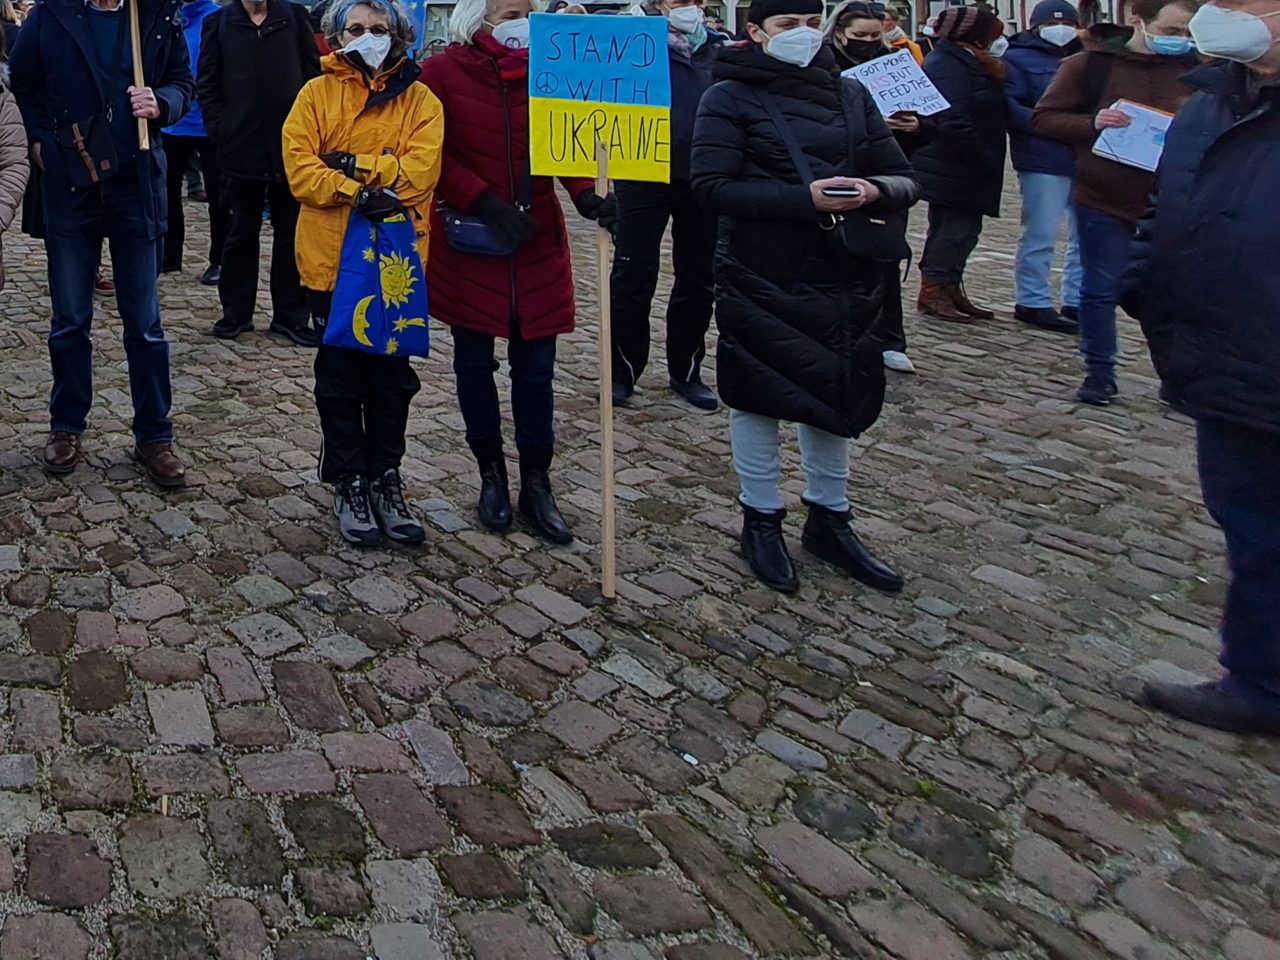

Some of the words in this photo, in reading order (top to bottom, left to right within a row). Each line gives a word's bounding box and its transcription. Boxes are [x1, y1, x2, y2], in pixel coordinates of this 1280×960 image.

[546, 32, 655, 67] STAND
[860, 62, 881, 77] GOT
[883, 52, 912, 71] MONEY
[888, 65, 912, 83] BUT
[565, 77, 650, 104] WITH
[878, 84, 910, 101] FEED
[908, 76, 931, 91] THE
[550, 109, 670, 162] UKRAINE
